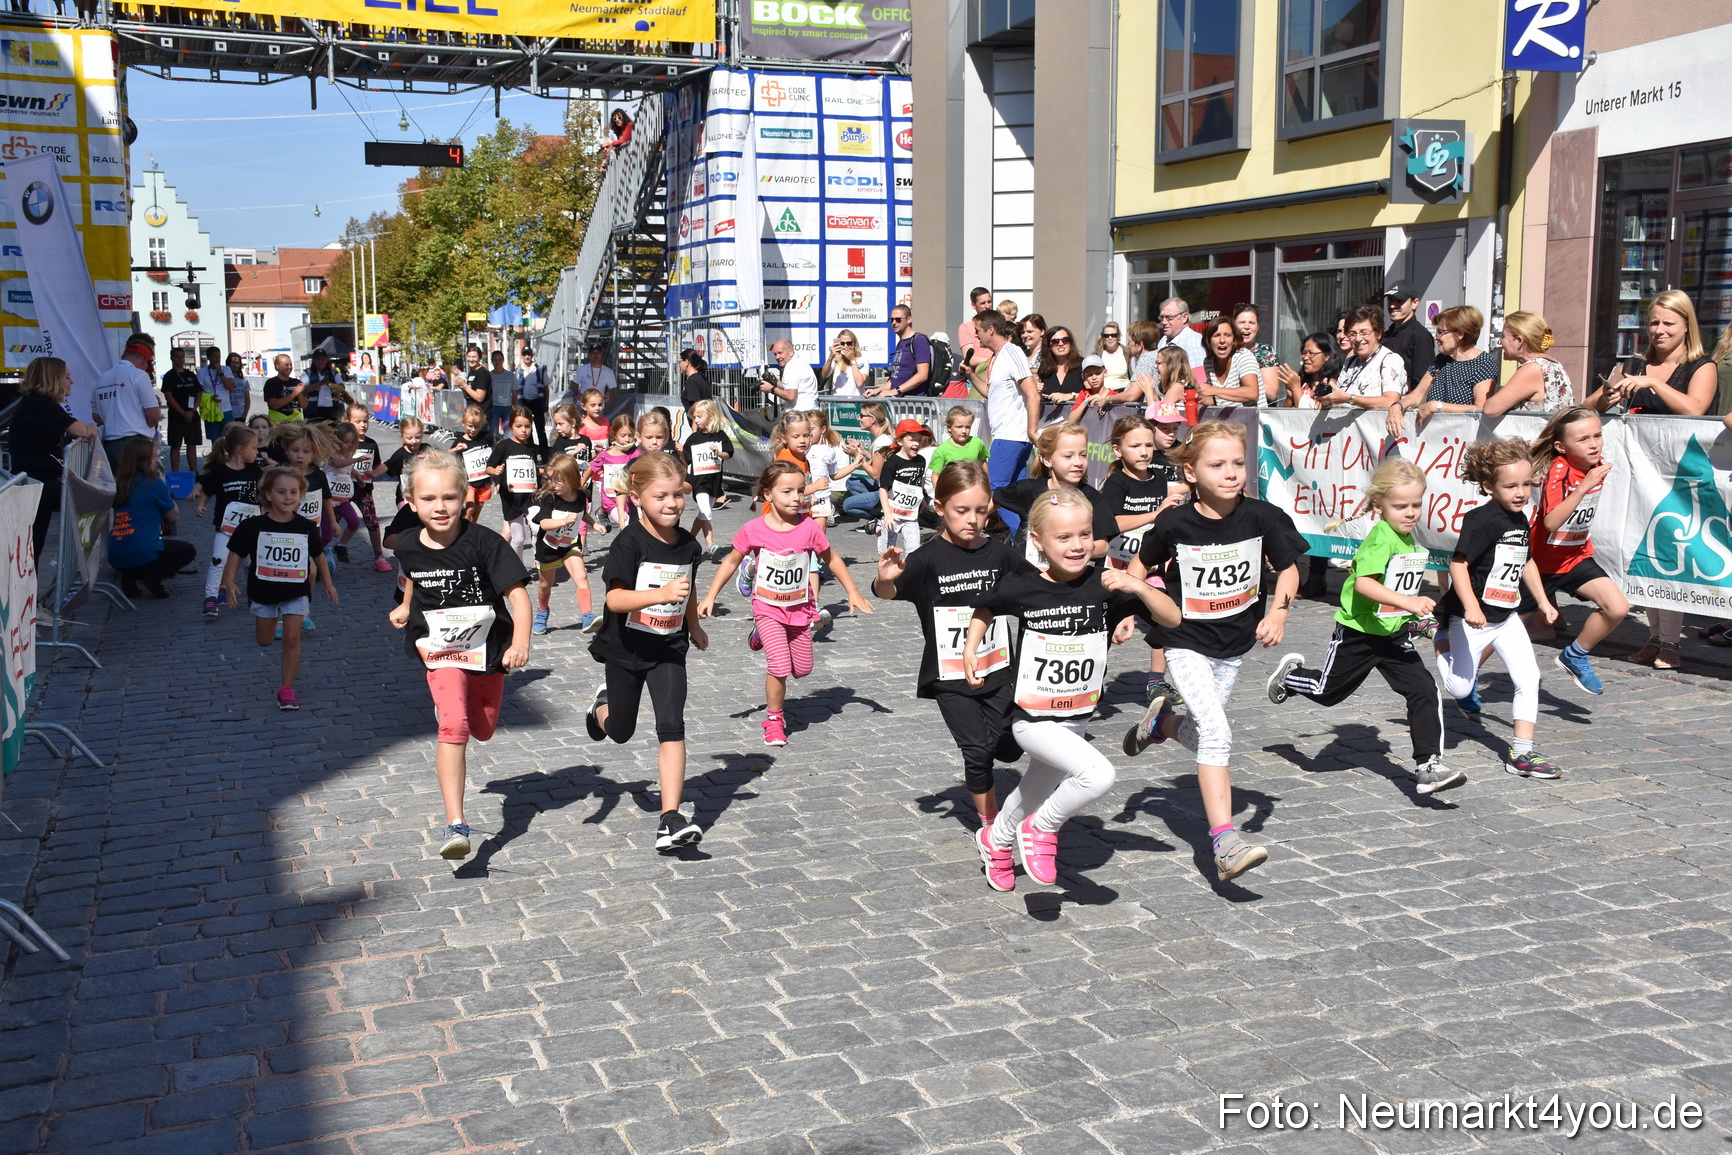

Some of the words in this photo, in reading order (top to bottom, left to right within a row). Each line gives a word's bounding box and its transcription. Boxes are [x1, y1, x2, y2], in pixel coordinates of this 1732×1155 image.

[570, 3, 634, 15] Neumarkter
[637, 4, 687, 16] Stadtlauf
[753, 1, 865, 28] BOCK
[752, 27, 786, 36] inspired
[789, 28, 799, 38] by
[802, 30, 827, 38] smart
[829, 32, 868, 40] concepts
[34, 59, 59, 67] KANN
[788, 87, 806, 95] CODE
[789, 94, 810, 102] CLINIC
[1586, 95, 1627, 116] Unterer
[1630, 87, 1664, 107] Markt
[1668, 81, 1682, 99] 15
[0, 109, 28, 117] adtwerke
[449, 148, 460, 164] 4
[1425, 142, 1449, 175] G2
[848, 264, 864, 274] Braun
[764, 299, 798, 310] swn
[1200, 310, 1220, 320] HAPPY
[793, 344, 816, 352] OTEC
[1087, 442, 1118, 463] FFICE
[356, 461, 371, 471] 037
[513, 468, 534, 479] 7518
[331, 482, 350, 493] 7099
[893, 491, 917, 507] 7350
[301, 501, 318, 513] 469
[1119, 535, 1140, 554] 70
[264, 545, 301, 562] 7050
[1202, 549, 1239, 561] BOCK
[766, 566, 803, 585] 7500
[938, 570, 989, 584] Neumarkter
[1192, 561, 1251, 588] 7432
[940, 580, 982, 594] Stadtlauf
[1218, 587, 1242, 596] Neumarkt
[774, 593, 790, 601] Julia
[1627, 583, 1644, 596] Jura
[1647, 585, 1688, 602] Gebäude
[1691, 592, 1726, 607] Service
[1210, 598, 1240, 610] Emma
[1024, 605, 1083, 618] Neumarkter
[649, 616, 677, 627] Theresa
[1027, 618, 1071, 629] Stadtlauf
[1046, 643, 1085, 653] BOCK
[427, 652, 468, 662] Franziska
[1034, 657, 1095, 684] 7360
[1037, 686, 1055, 694] PARTL
[1051, 698, 1073, 708] Leni
